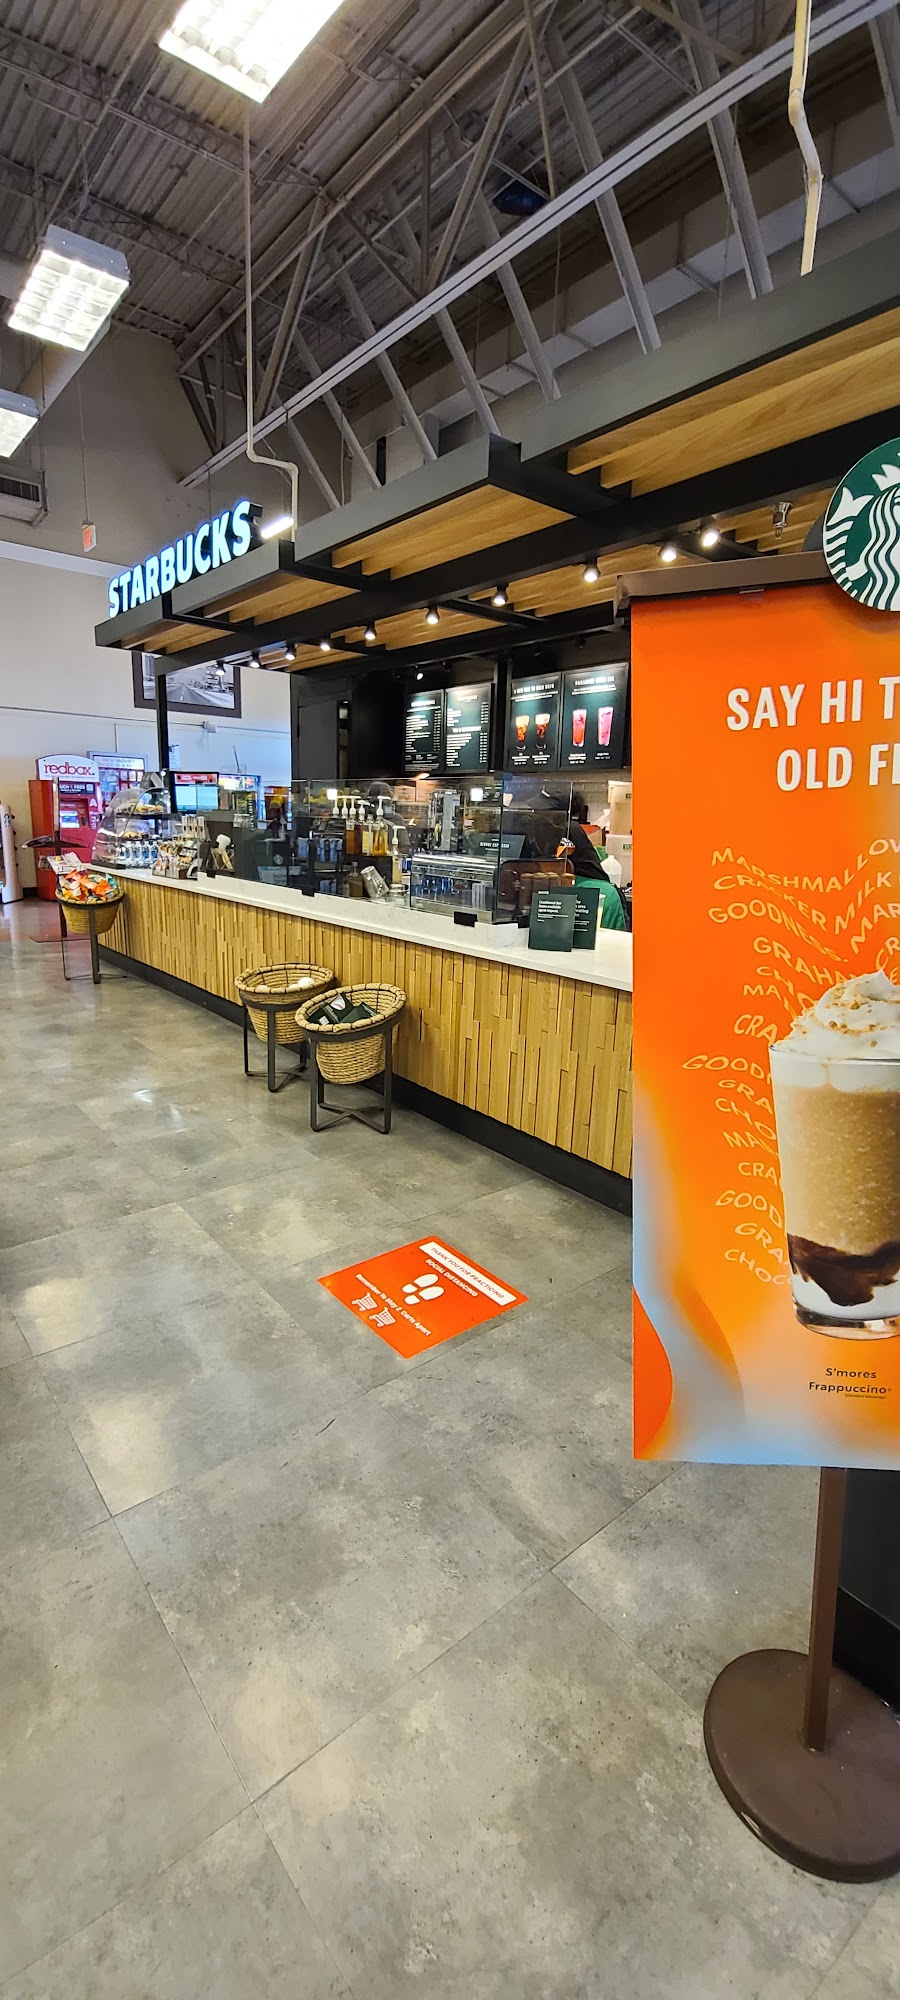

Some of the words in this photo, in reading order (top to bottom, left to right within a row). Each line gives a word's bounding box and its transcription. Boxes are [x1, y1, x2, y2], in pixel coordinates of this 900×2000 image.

[108, 500, 252, 618] STARBUCKS
[727, 683, 805, 731] SAY
[821, 679, 863, 724] HI
[777, 745, 853, 791] OLD
[713, 874, 827, 931] CRACKER
[834, 871, 892, 935] MILK
[753, 936, 858, 986] GRAHA
[734, 1222, 790, 1266] GRA
[425, 1258, 446, 1274] SOCIAL
[443, 1271, 479, 1297] DISTANCING
[430, 1247, 449, 1261] THANK
[448, 1257, 461, 1269] YOU
[459, 1264, 472, 1276] FOR
[469, 1273, 505, 1299] PRACTICING
